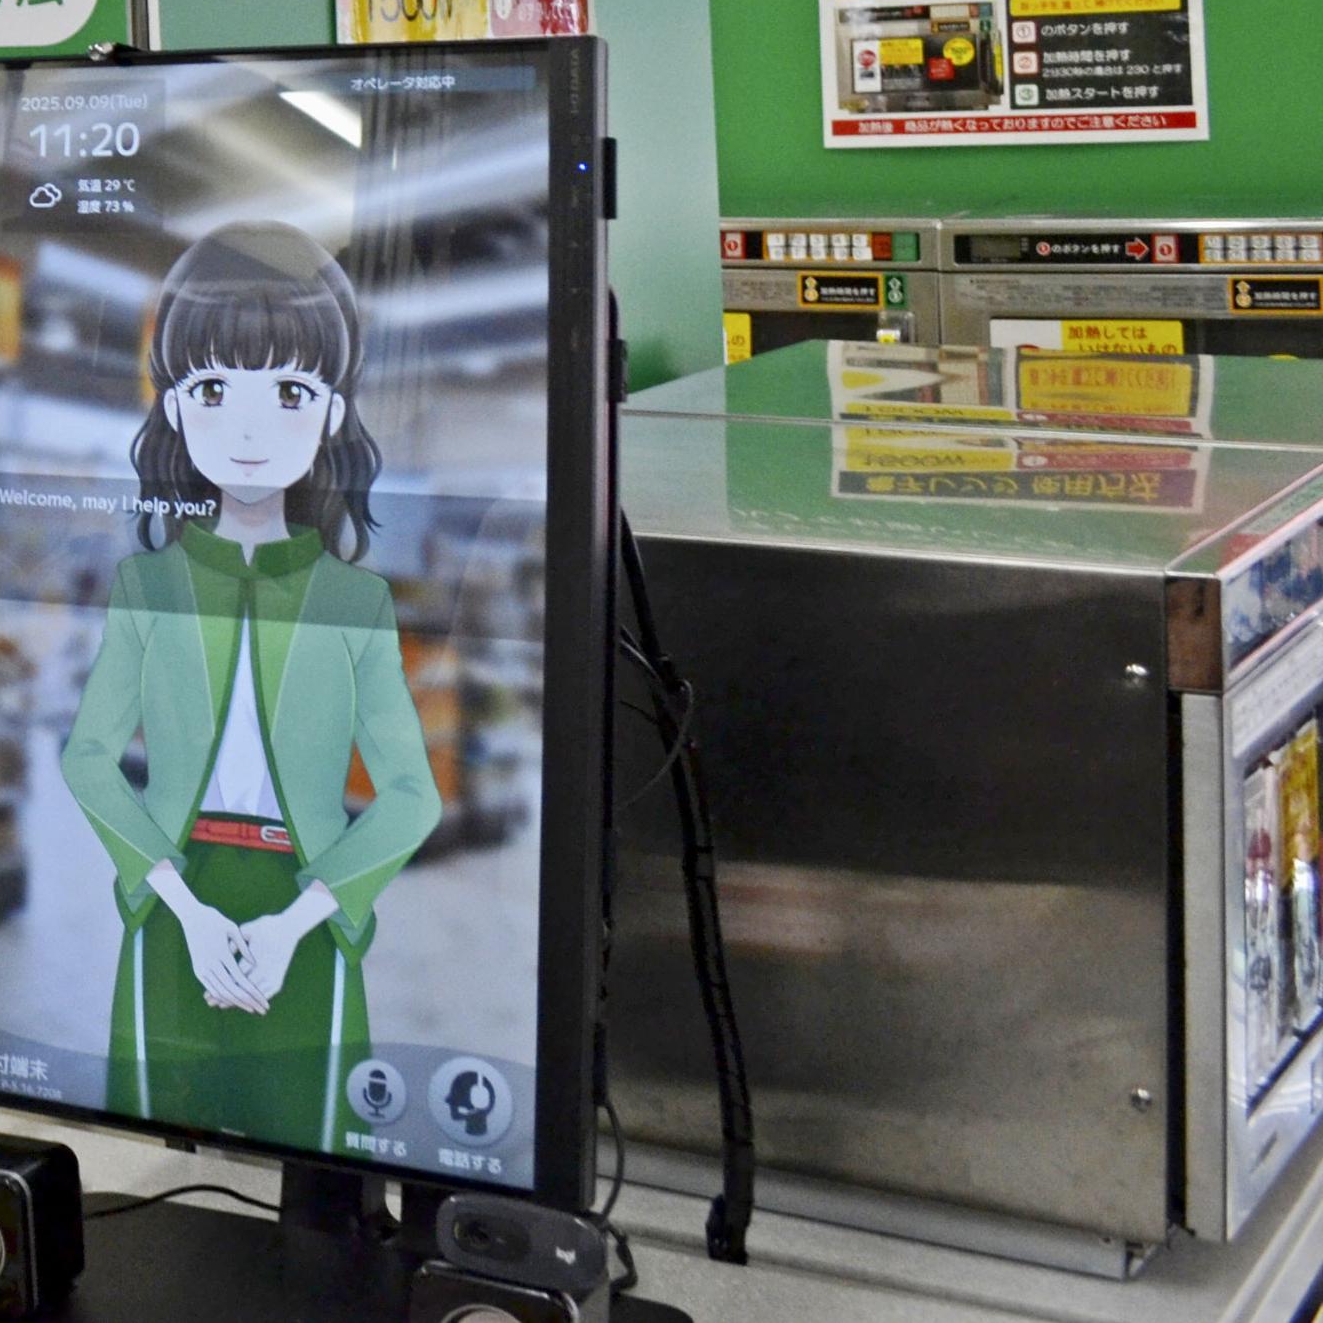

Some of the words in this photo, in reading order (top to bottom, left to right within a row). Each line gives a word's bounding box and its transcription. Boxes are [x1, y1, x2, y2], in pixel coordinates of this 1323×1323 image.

[351, 75, 455, 91] オペレータ対応中
[21, 94, 148, 111] 2025.09.09(Tue)
[29, 122, 140, 157] 11:20
[105, 179, 120, 192] 29
[105, 200, 120, 212] 73
[82, 496, 117, 512] may
[132, 496, 170, 516] help
[174, 499, 217, 518] you?
